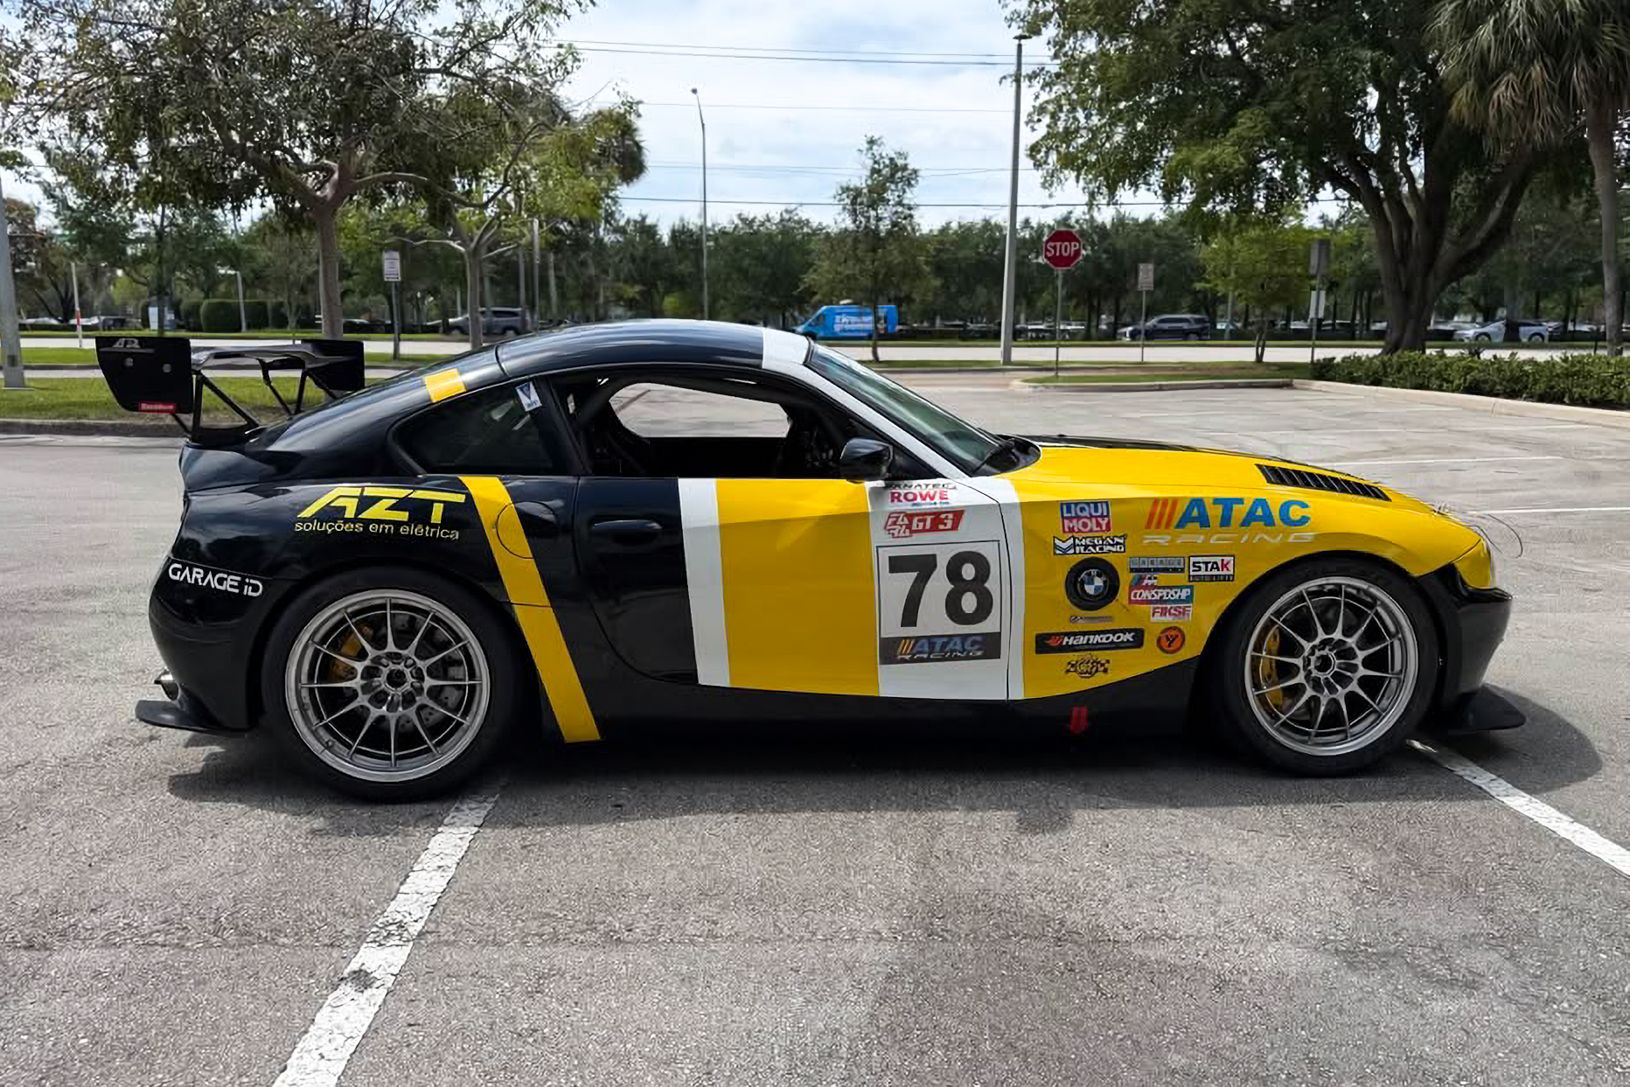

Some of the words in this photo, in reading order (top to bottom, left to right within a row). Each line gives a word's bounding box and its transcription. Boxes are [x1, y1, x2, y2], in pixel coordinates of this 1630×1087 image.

[1046, 241, 1079, 257] STOP
[890, 490, 949, 503] ROWE
[297, 486, 466, 524] AZT
[1063, 502, 1108, 517] LIQUI
[1174, 497, 1312, 529] ATAC
[911, 514, 935, 530] GT
[938, 513, 954, 529] 3
[1064, 517, 1109, 532] MOLY
[294, 519, 364, 536] soluções
[369, 523, 394, 533] em
[400, 522, 460, 541] elétrica
[1075, 536, 1126, 545] MEGAN
[1141, 532, 1317, 545] RACING
[1076, 545, 1125, 554] RACING
[168, 562, 240, 594] GARAGE
[888, 551, 993, 627] 78
[912, 635, 984, 653] ATAC
[897, 650, 985, 660] RACING
